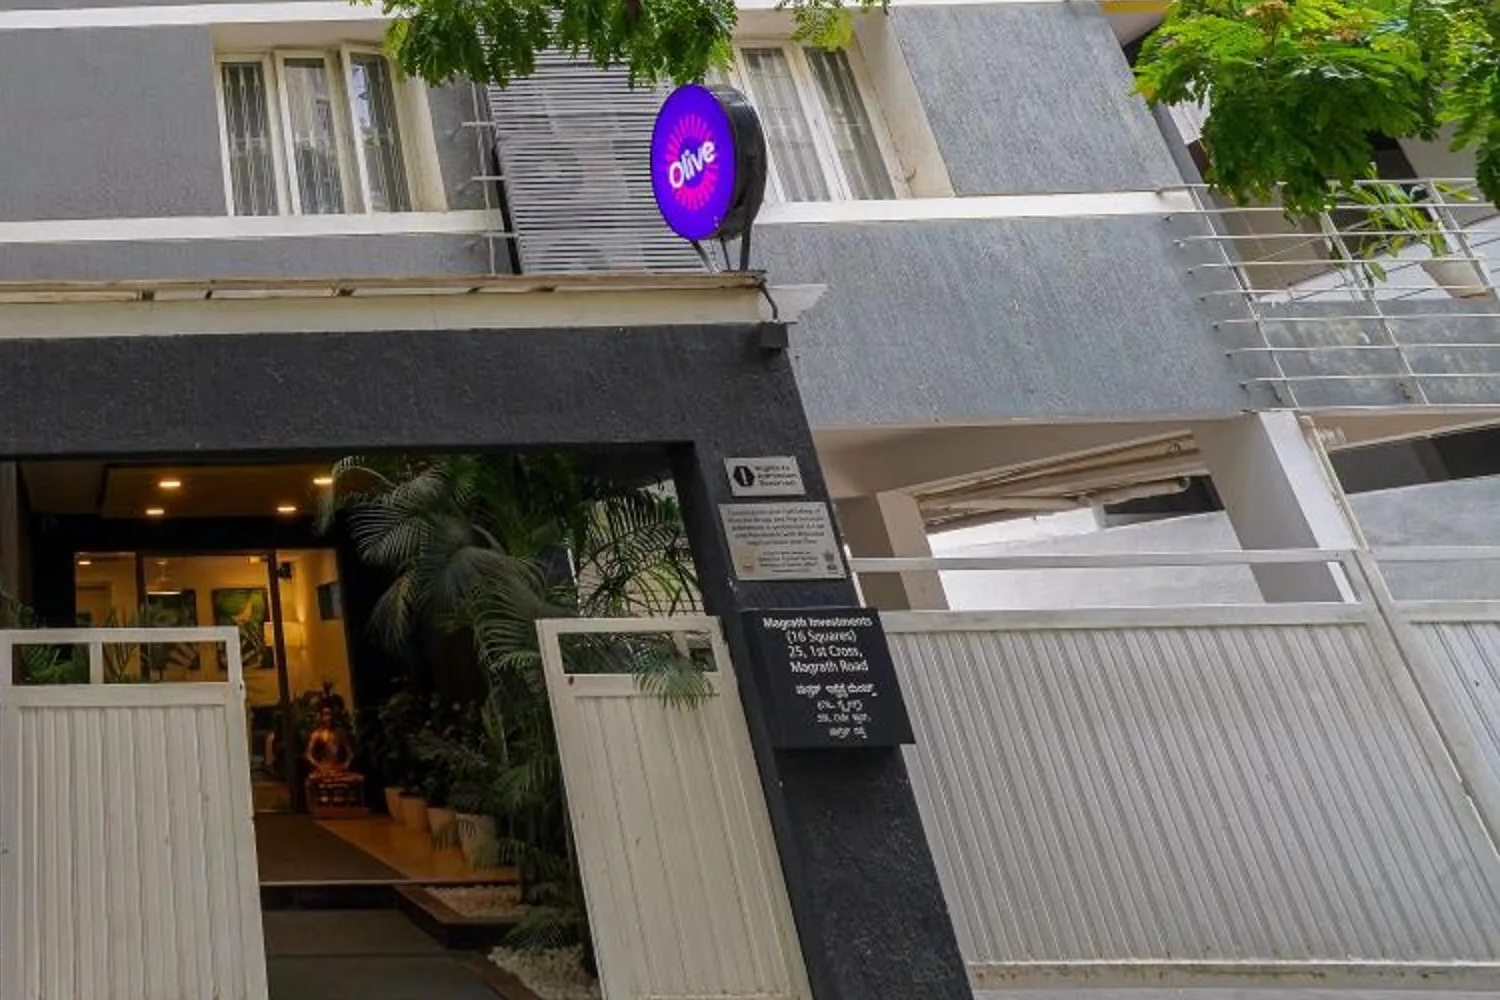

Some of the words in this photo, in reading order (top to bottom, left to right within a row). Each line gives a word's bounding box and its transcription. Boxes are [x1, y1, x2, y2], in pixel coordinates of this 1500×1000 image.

[669, 141, 715, 188] Olive
[763, 617, 807, 630] Magrath
[787, 630, 806, 643] (16
[788, 645, 808, 659] 25,
[811, 645, 827, 657] 1st
[829, 645, 863, 658] Cross,
[790, 661, 838, 676] Magrath
[840, 659, 868, 673] Road
